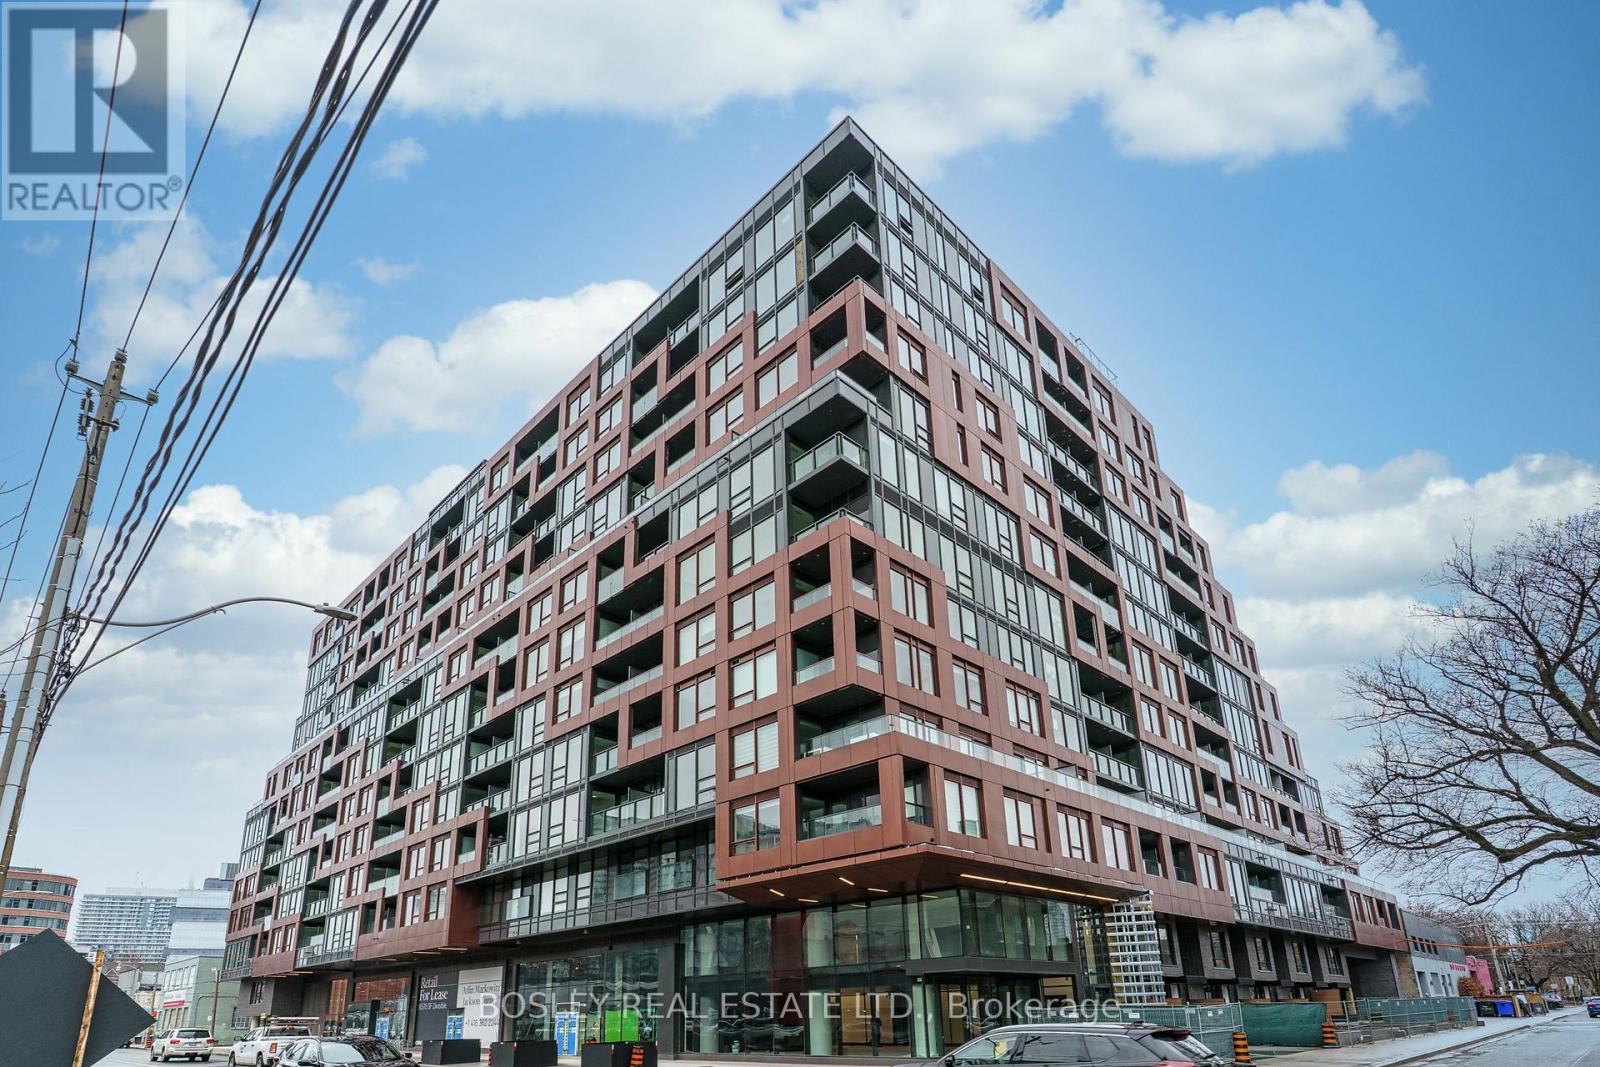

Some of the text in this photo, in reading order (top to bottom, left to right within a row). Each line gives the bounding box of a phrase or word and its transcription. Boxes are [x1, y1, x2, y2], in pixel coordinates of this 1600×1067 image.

[421, 976, 438, 989] Retail
[420, 989, 449, 1001] For Lease
